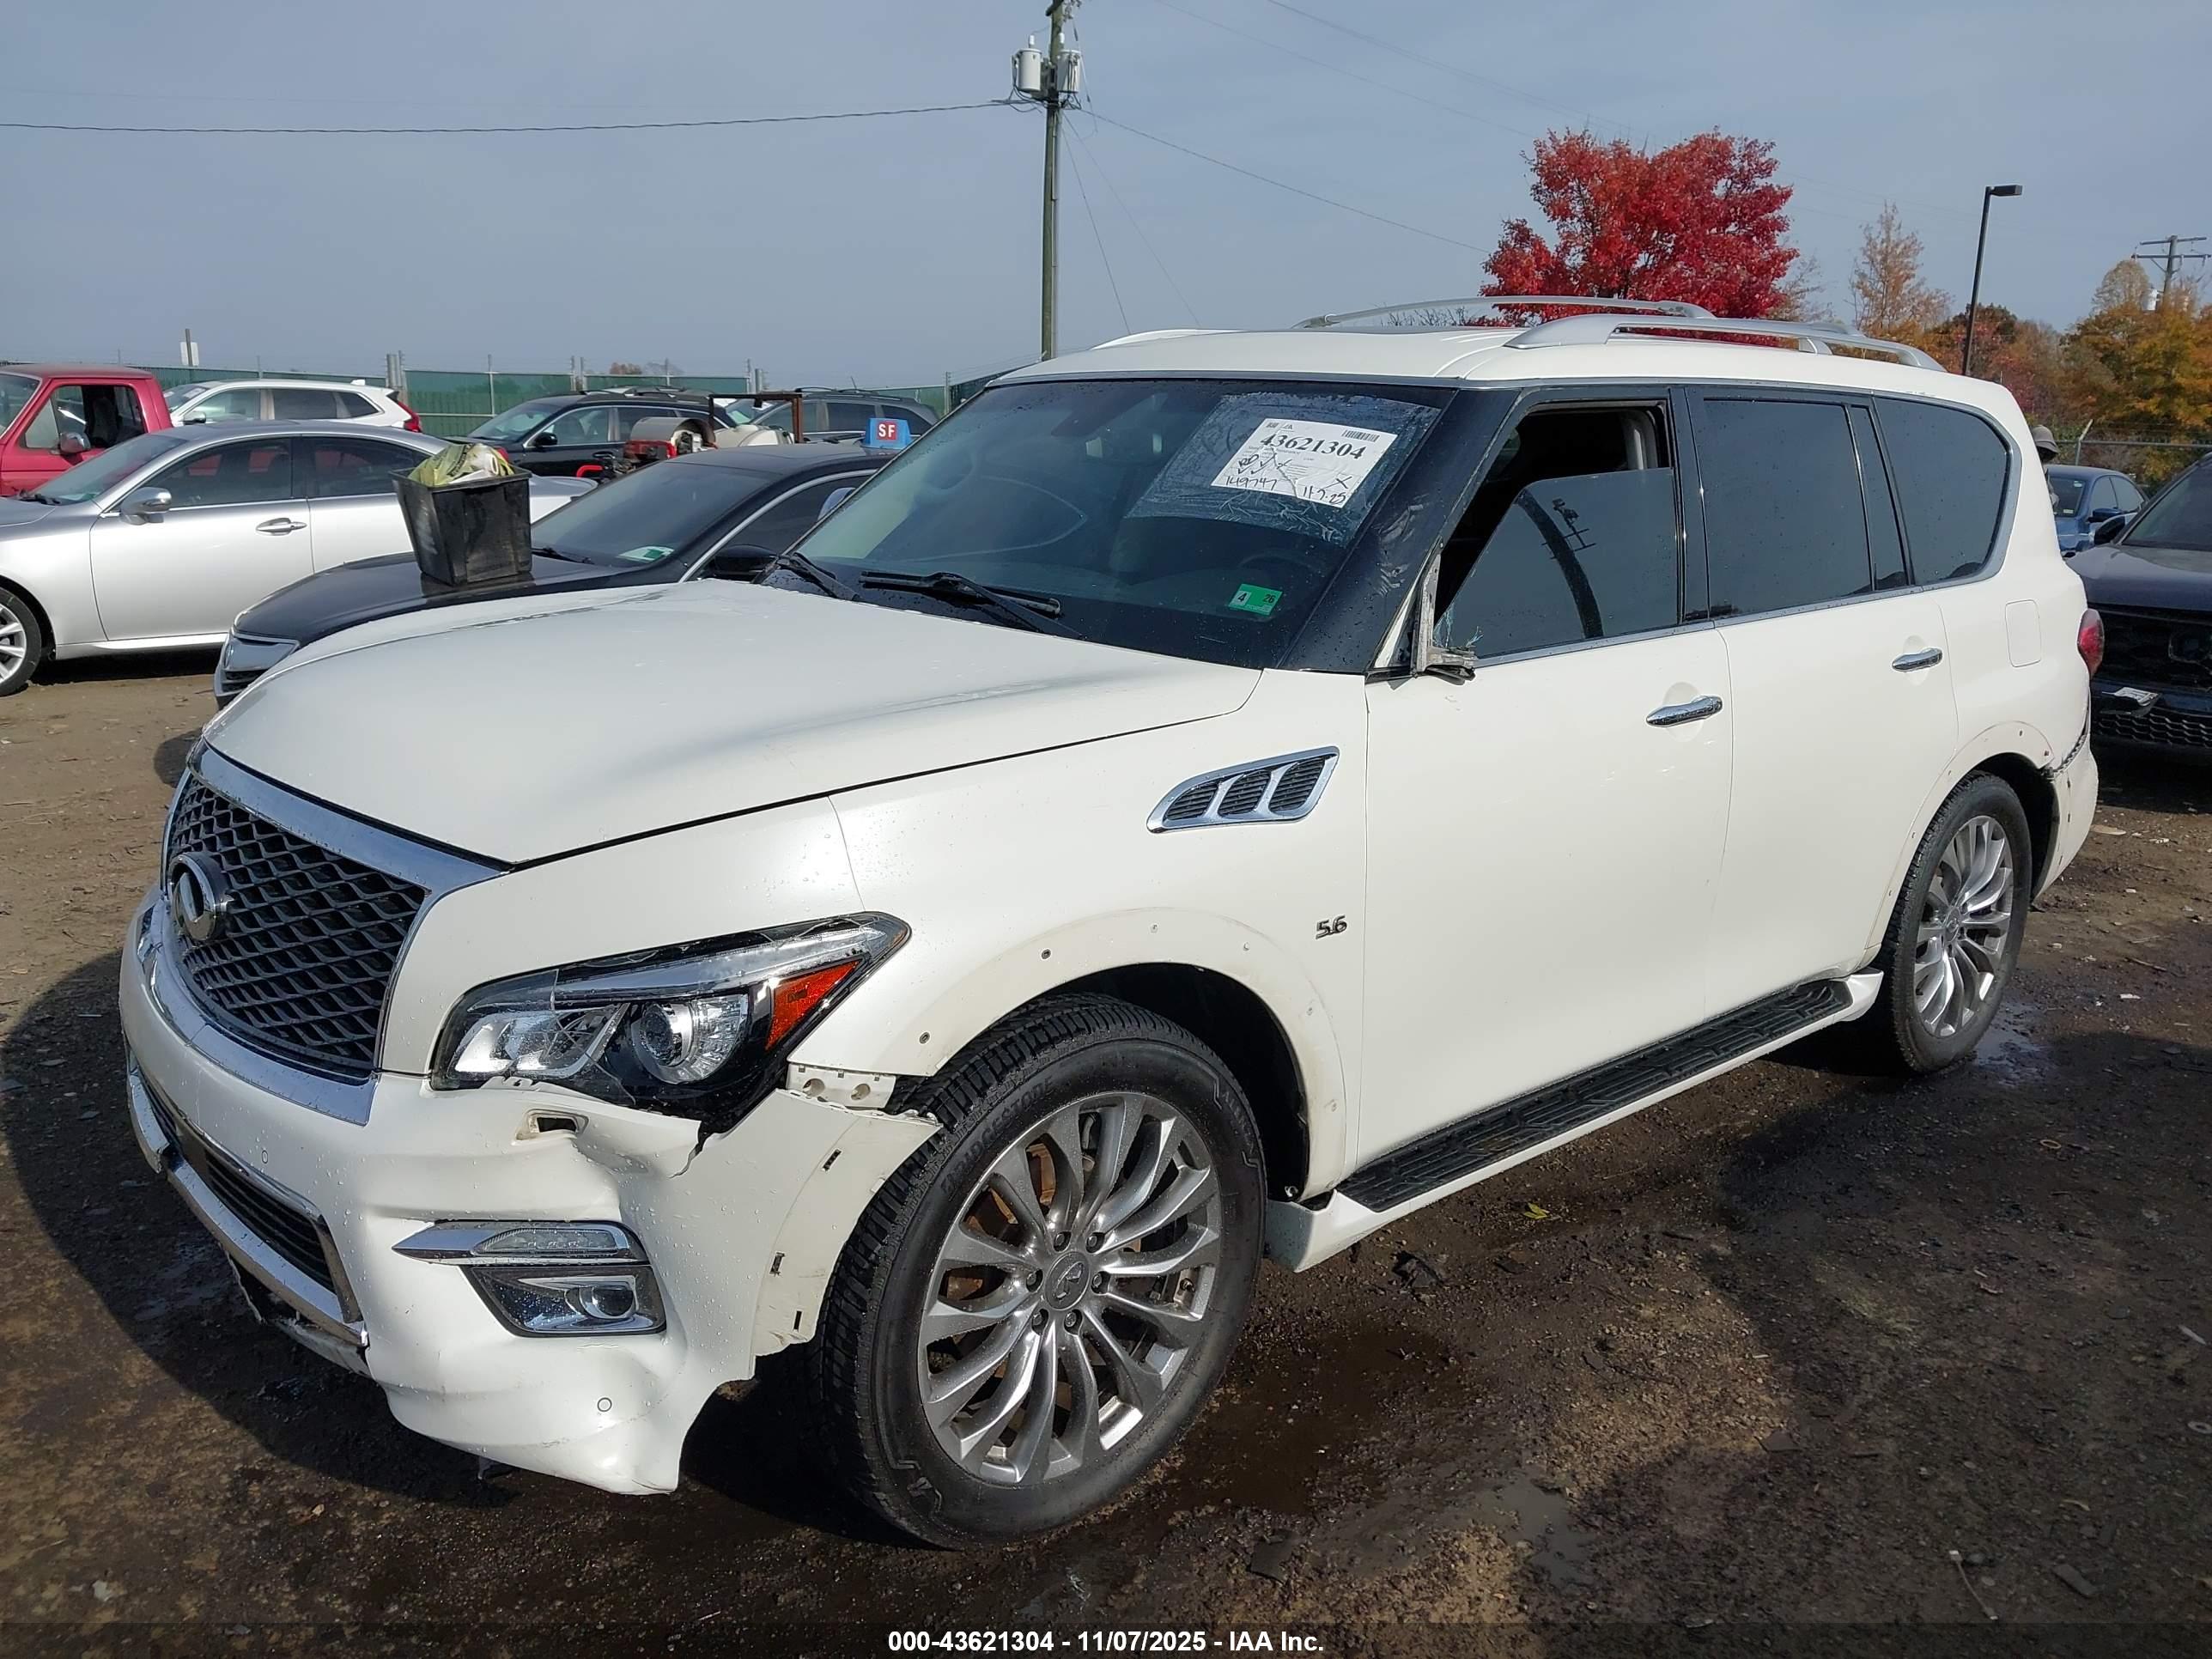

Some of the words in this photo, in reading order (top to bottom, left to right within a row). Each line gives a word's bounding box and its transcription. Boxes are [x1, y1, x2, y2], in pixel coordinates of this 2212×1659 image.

[878, 423, 896, 438] SF
[1261, 434, 1367, 459] 43621304
[1237, 592, 1248, 603] 4
